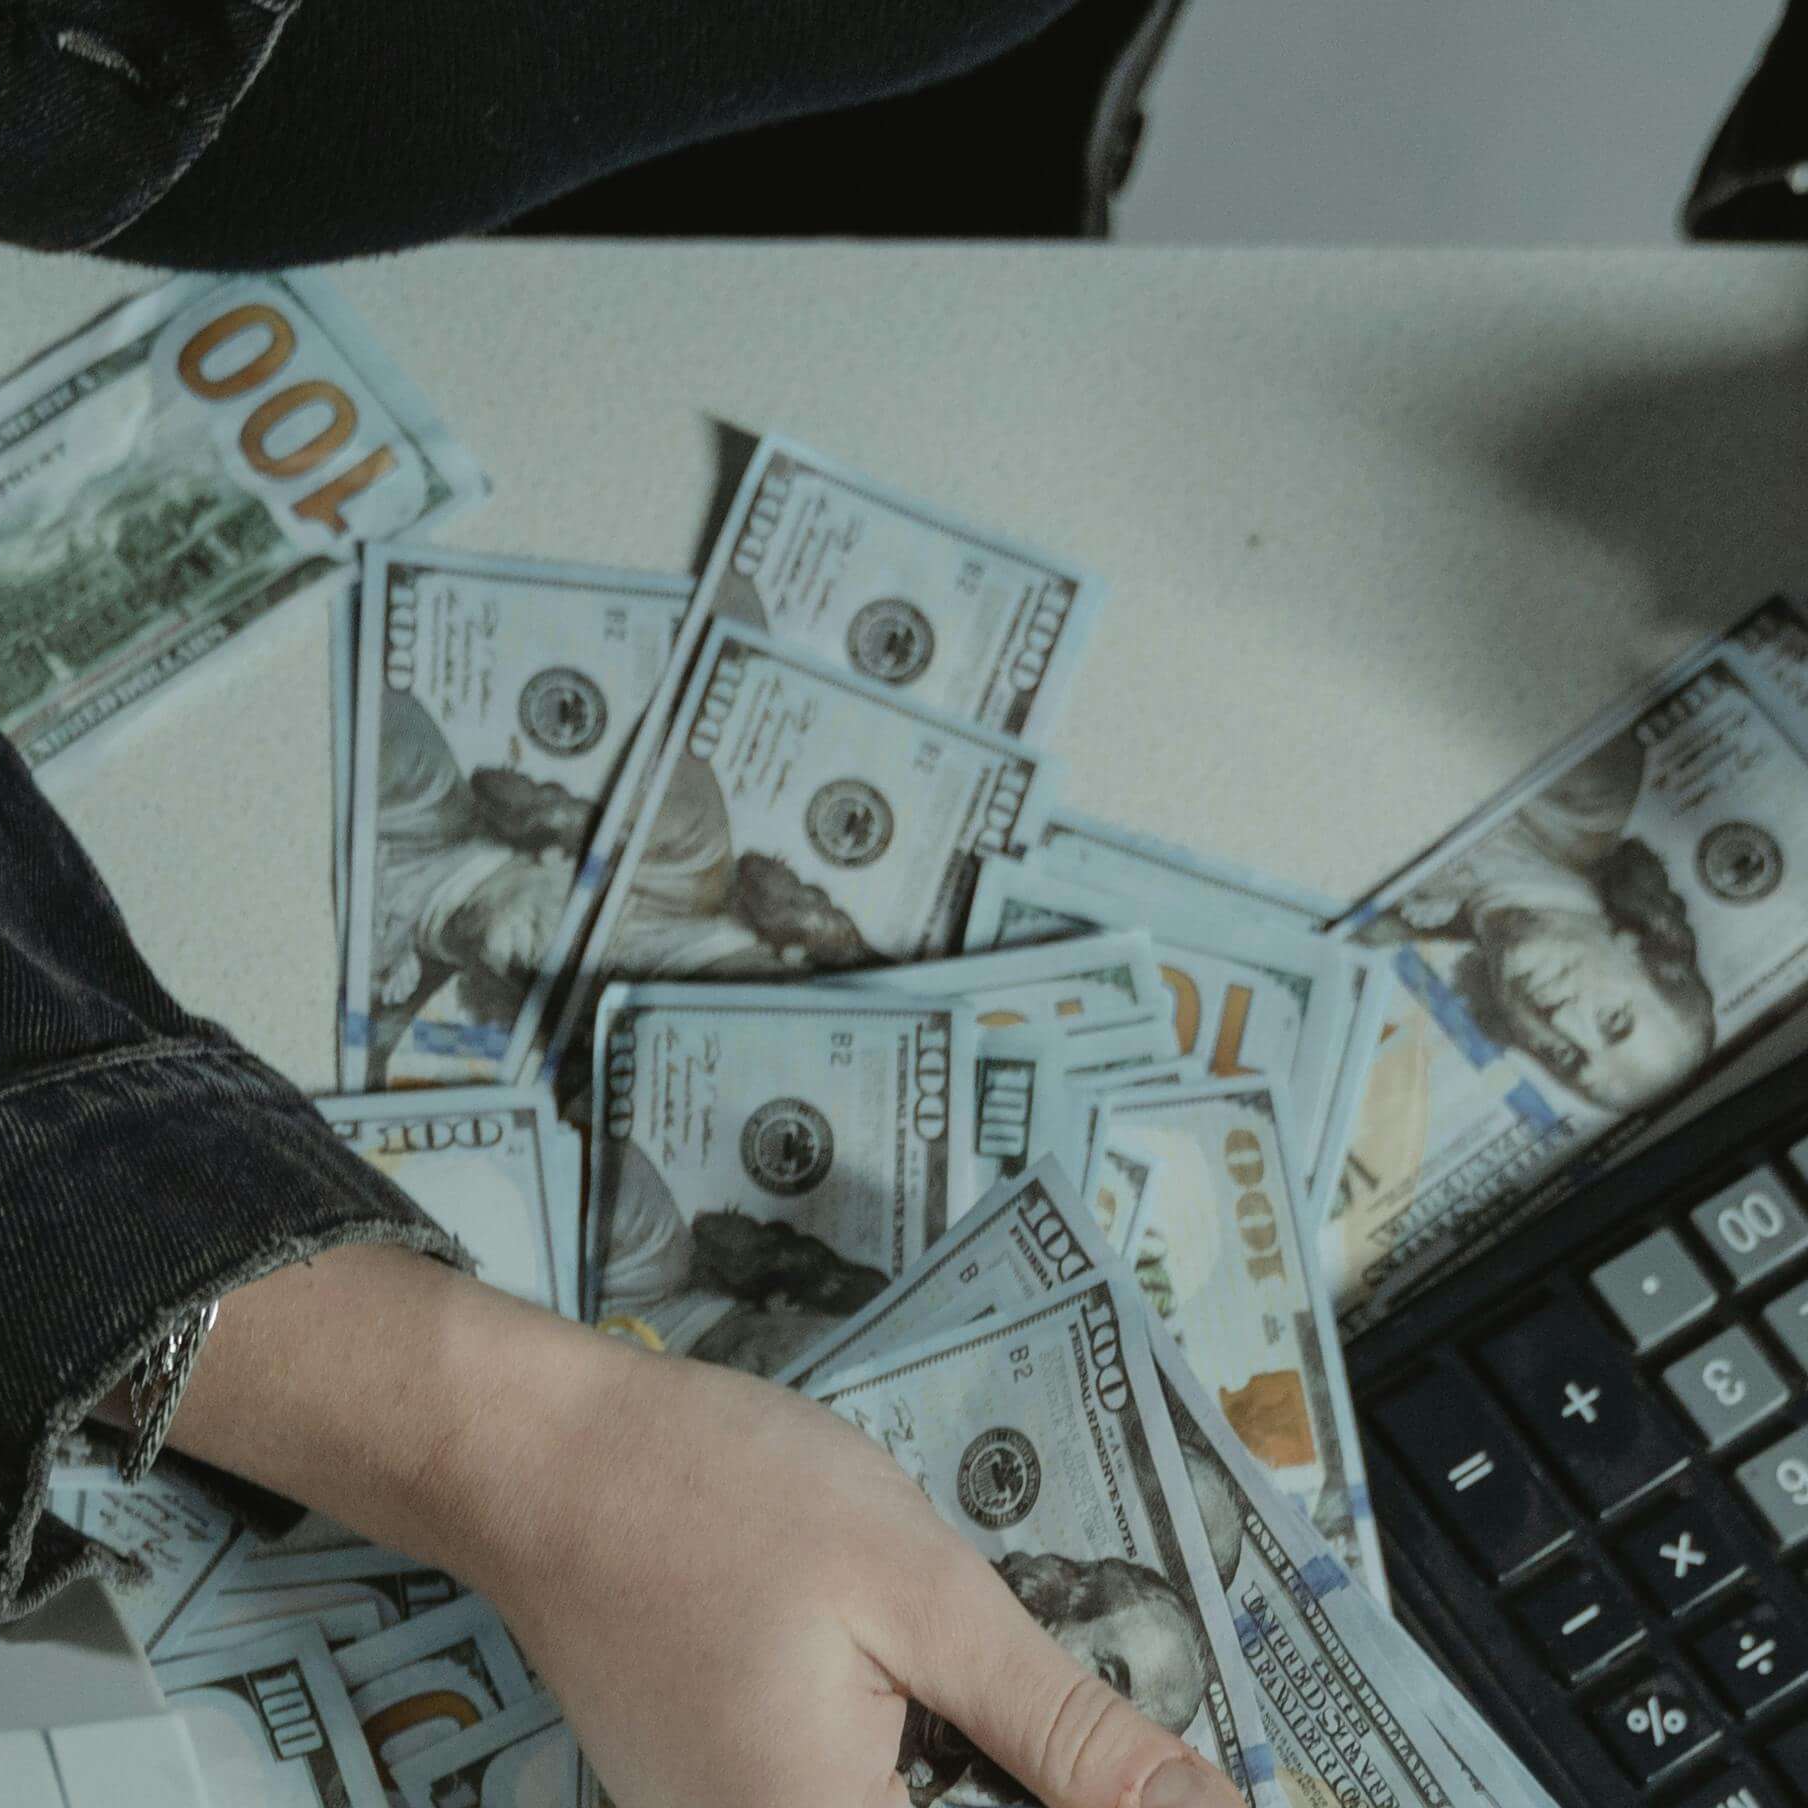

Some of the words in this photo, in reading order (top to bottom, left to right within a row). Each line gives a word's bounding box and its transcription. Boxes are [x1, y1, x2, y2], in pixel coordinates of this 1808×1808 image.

[178, 306, 386, 528] 100
[915, 1023, 945, 1140] 100
[1221, 1124, 1286, 1285] 100
[1718, 1194, 1782, 1252] 00
[1079, 1298, 1131, 1413] 100
[1703, 1360, 1745, 1405] 3
[1238, 1583, 1332, 1712] UNITED
